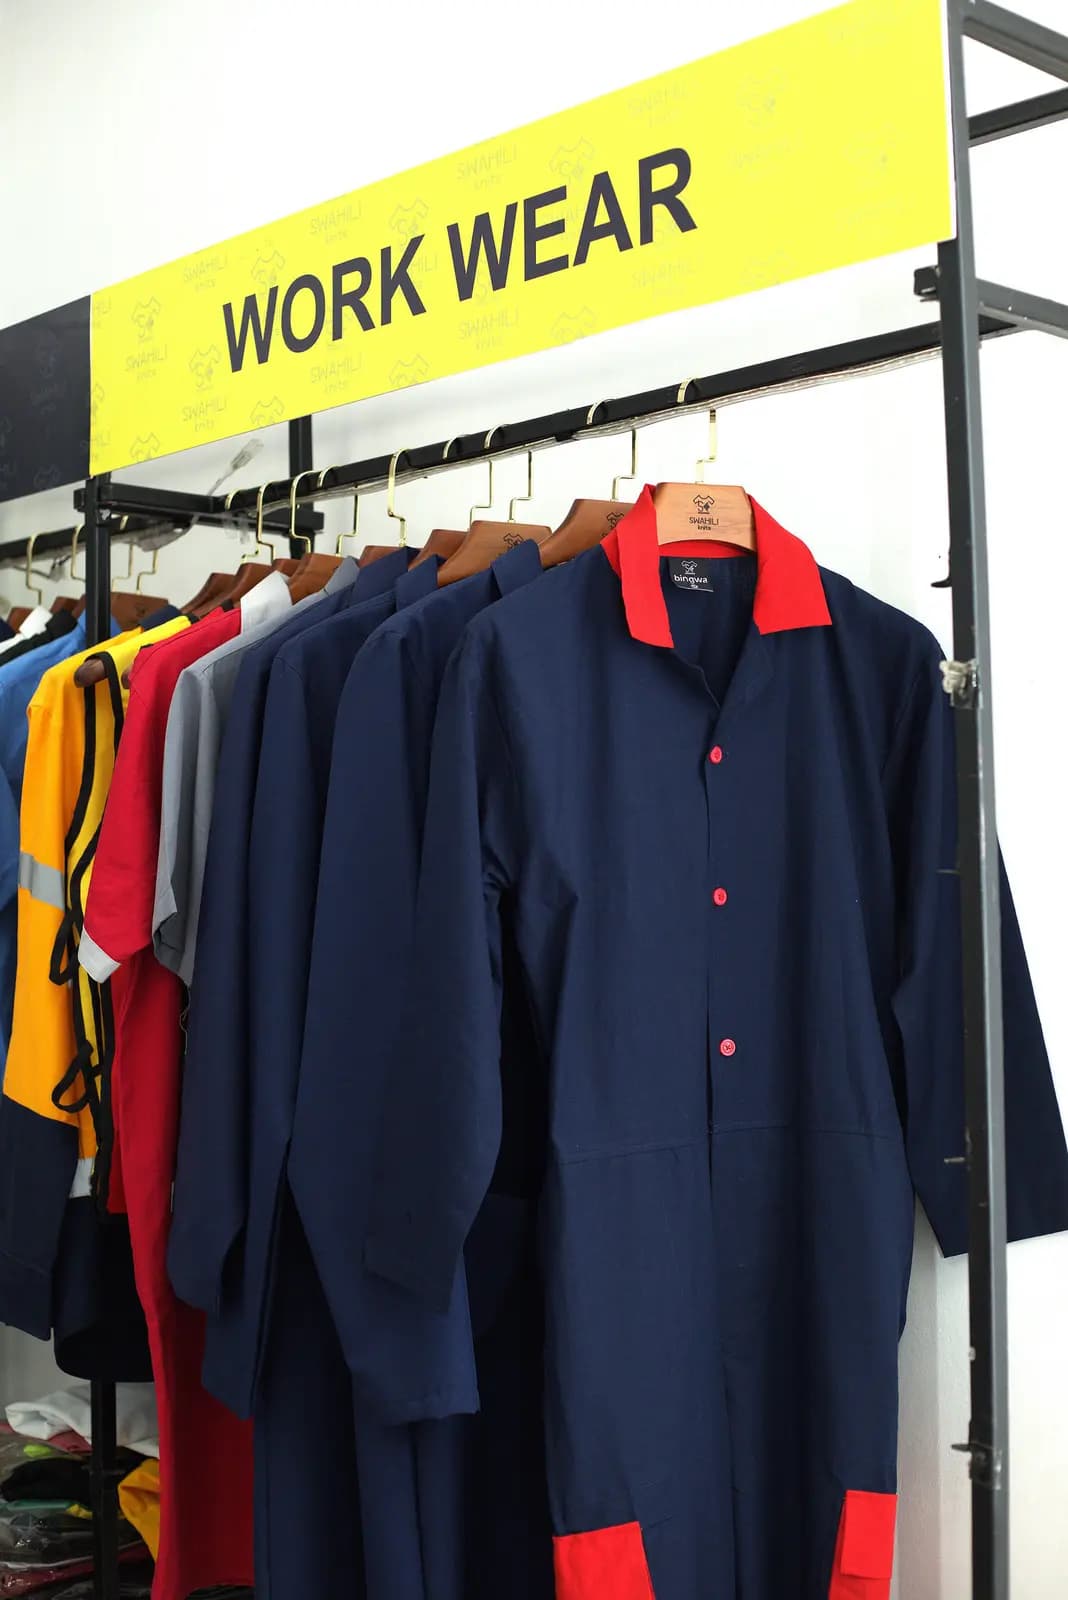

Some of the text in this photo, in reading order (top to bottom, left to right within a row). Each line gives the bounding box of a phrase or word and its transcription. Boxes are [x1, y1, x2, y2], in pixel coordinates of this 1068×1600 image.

[222, 147, 698, 374] WORK WEAR
[689, 516, 719, 526] SWAHILI
[674, 575, 708, 585] bingwa
